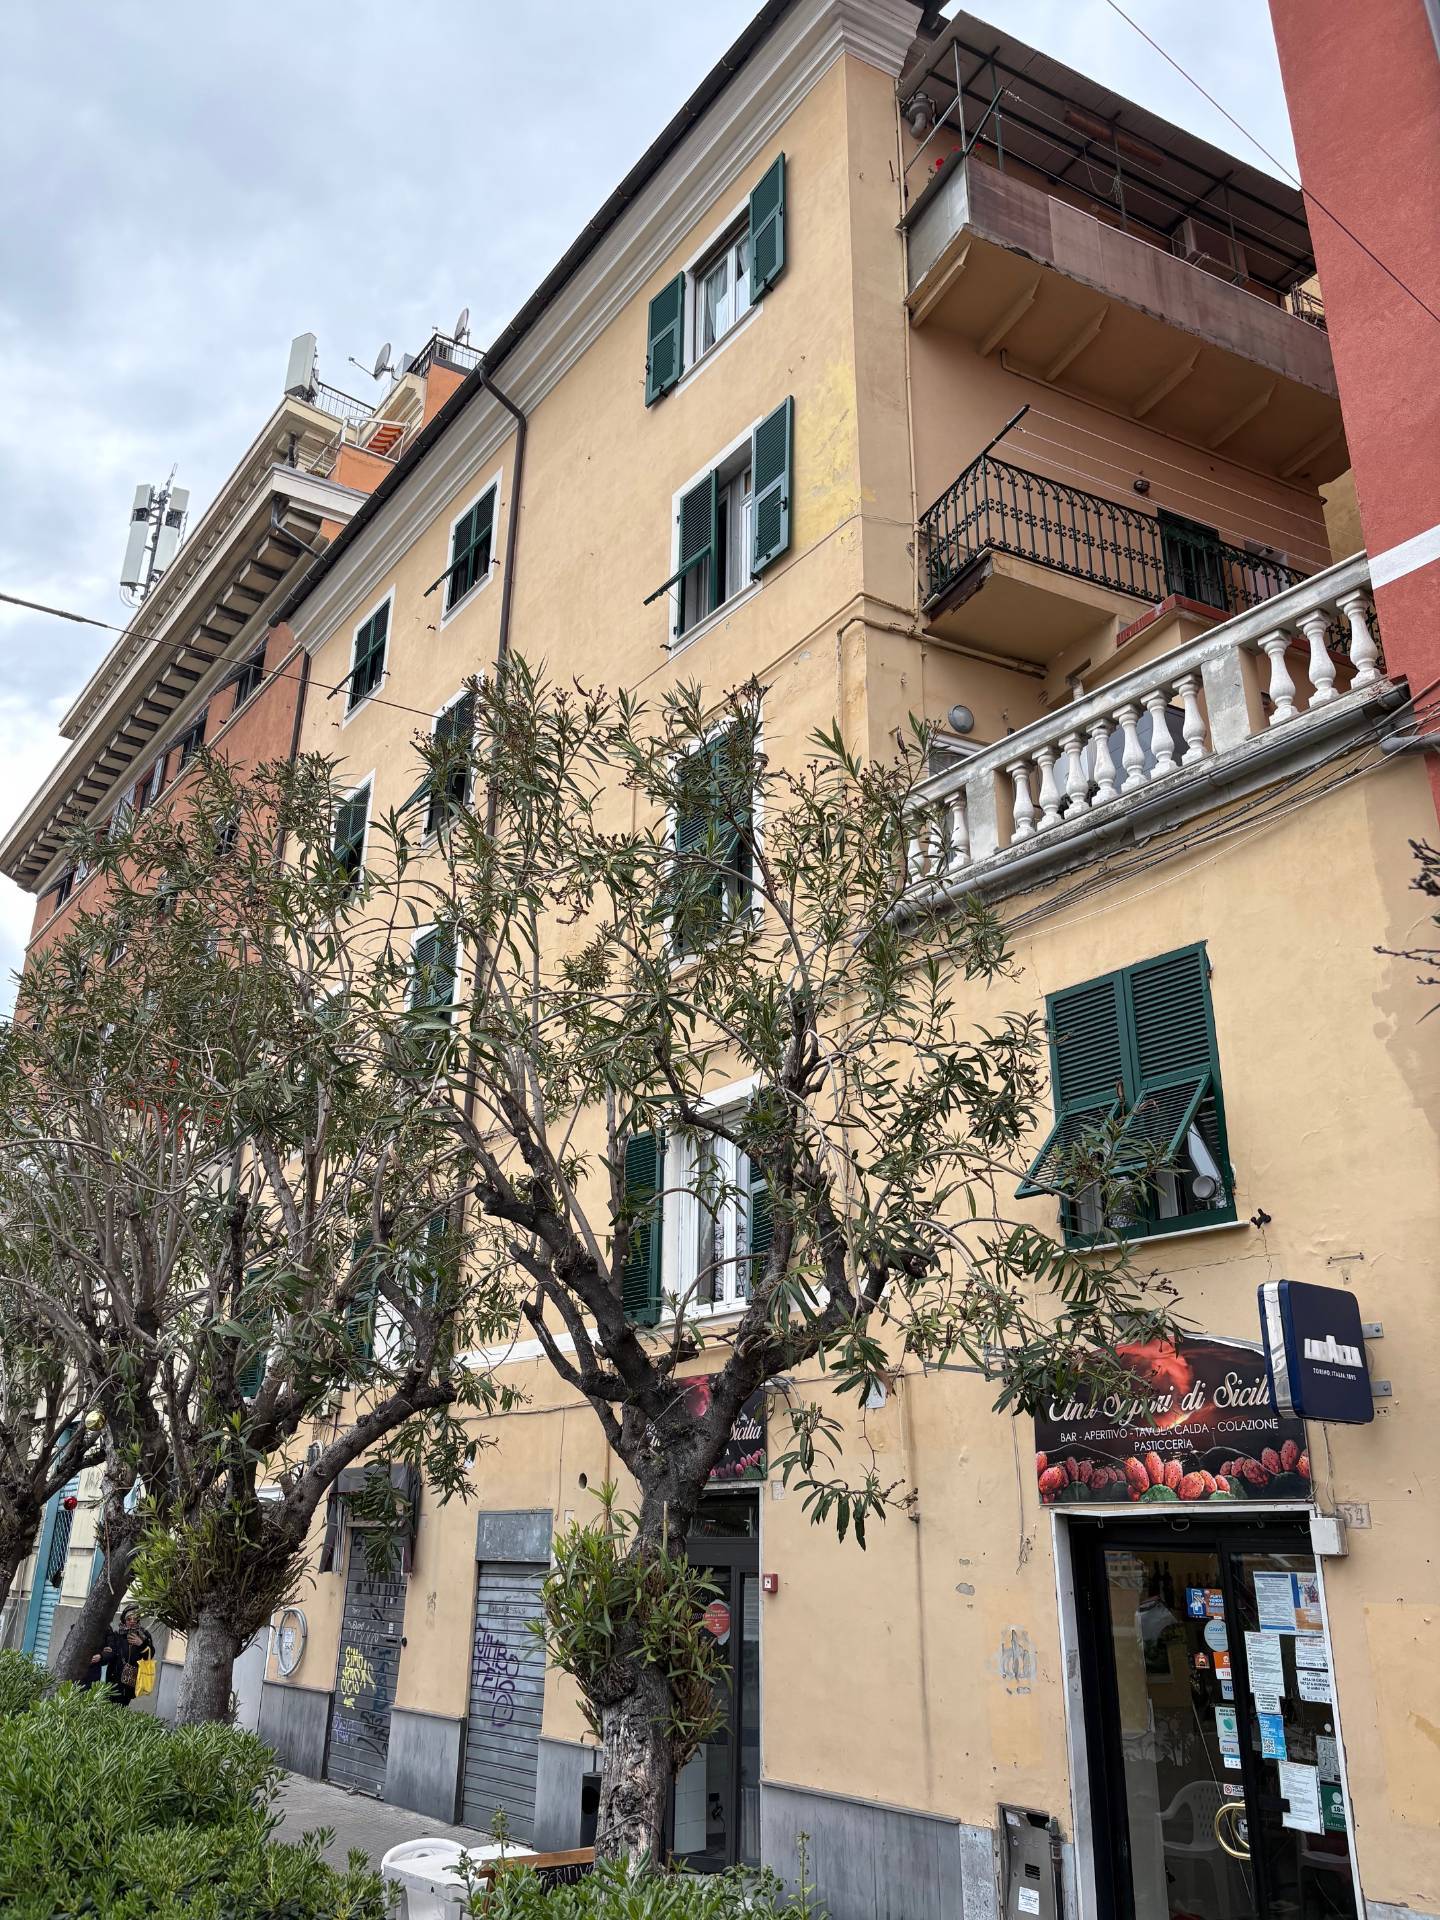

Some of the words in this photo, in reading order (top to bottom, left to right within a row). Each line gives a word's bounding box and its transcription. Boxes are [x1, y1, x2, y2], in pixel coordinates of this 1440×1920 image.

[1181, 1380, 1206, 1412] di
[1060, 1431, 1077, 1443] BAR
[1084, 1428, 1128, 1441] APERITIVO
[1174, 1422, 1209, 1435] CALDA
[1217, 1418, 1279, 1433] COLAZIONE
[1134, 1438, 1194, 1452] PASTICCERIA
